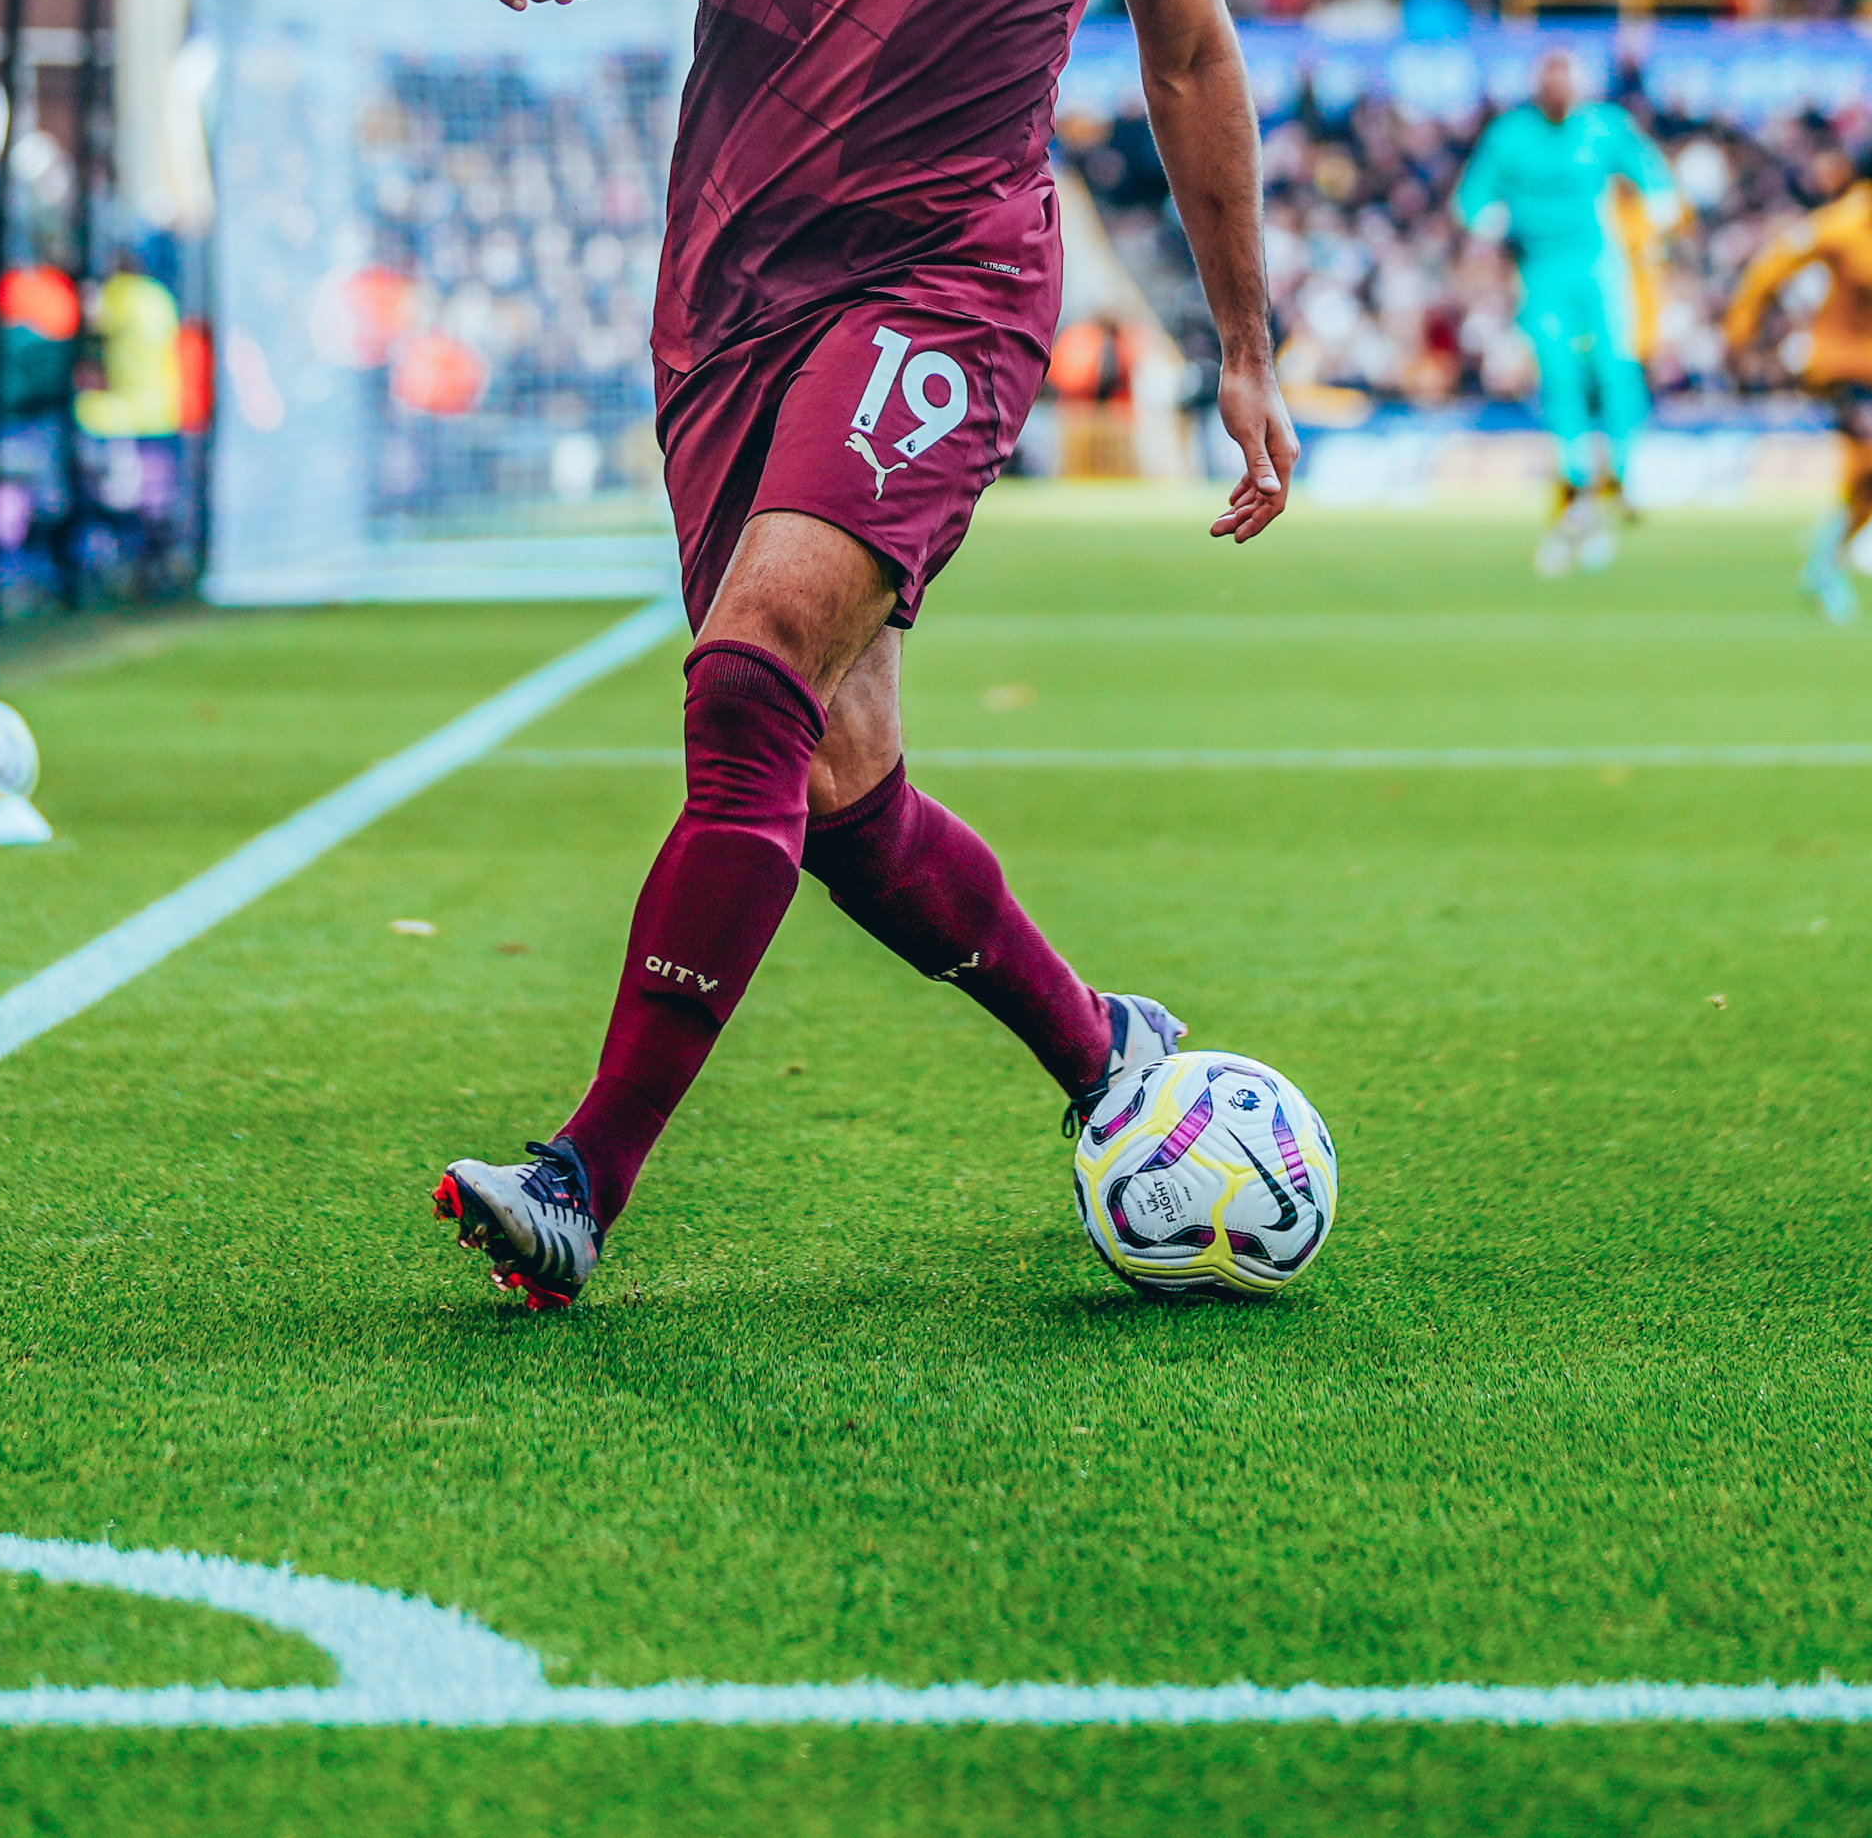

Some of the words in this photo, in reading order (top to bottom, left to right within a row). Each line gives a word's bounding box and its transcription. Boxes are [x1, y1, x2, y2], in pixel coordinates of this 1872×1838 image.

[850, 325, 970, 459] 19
[645, 955, 719, 993] CITY
[1153, 1181, 1177, 1223] FLIGHT
